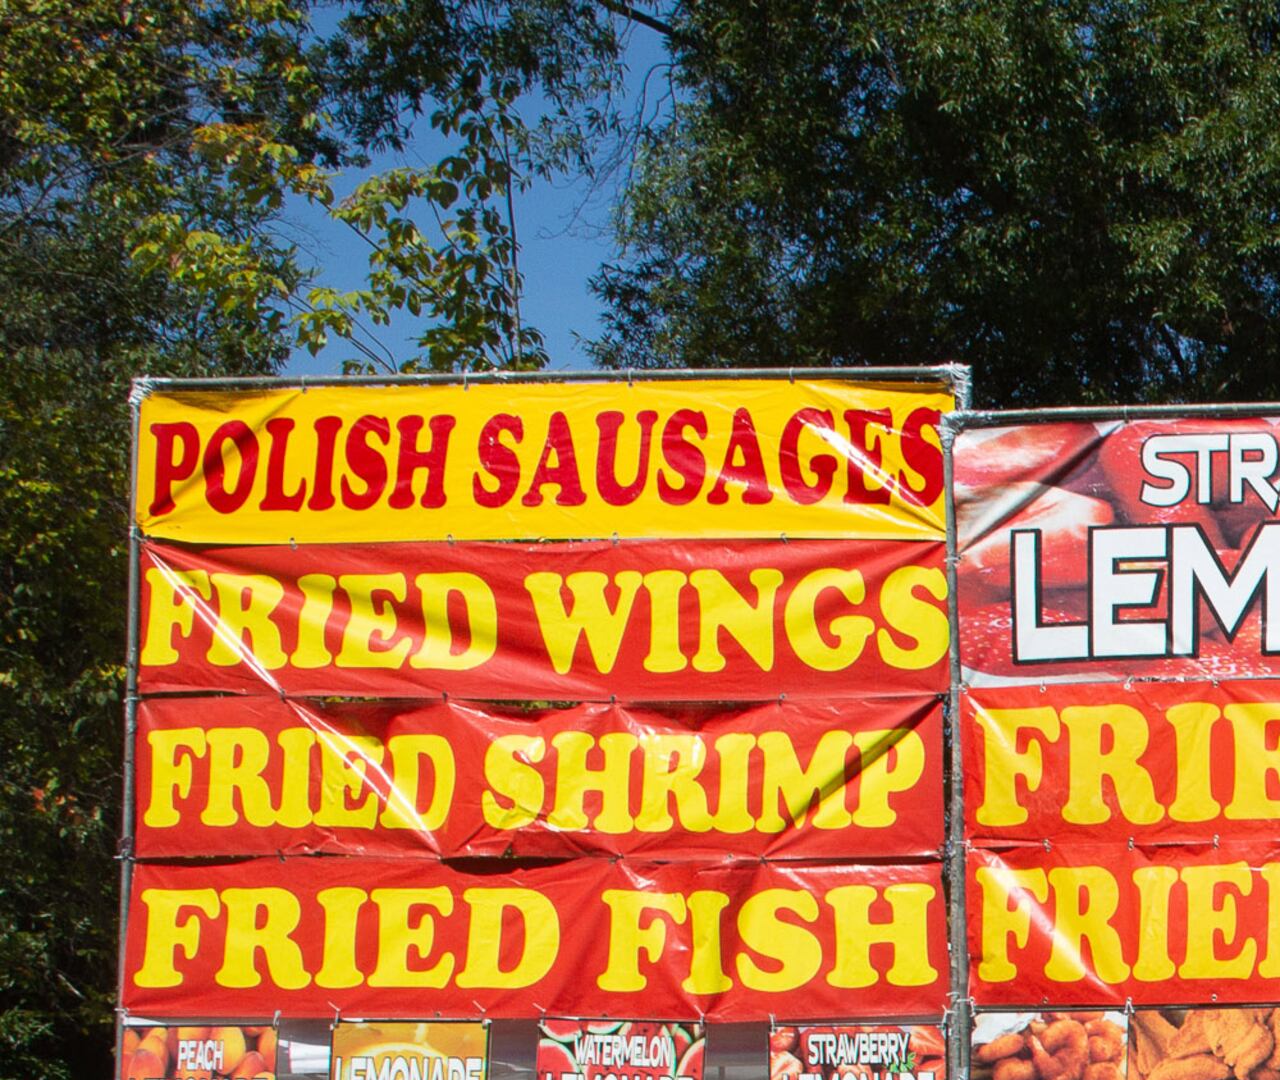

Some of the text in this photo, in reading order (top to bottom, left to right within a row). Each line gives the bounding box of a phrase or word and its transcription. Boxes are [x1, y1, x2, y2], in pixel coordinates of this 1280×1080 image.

[150, 406, 948, 516] POLISH SAUSAGES
[141, 565, 951, 675] FRIED WINGS
[143, 727, 926, 836] FRIED SHRIMP
[134, 883, 939, 996] FRIED FISH
[177, 1039, 224, 1071] PEACH
[574, 1033, 675, 1069] WATERMELON
[807, 1032, 911, 1073] STRAWBERRY
